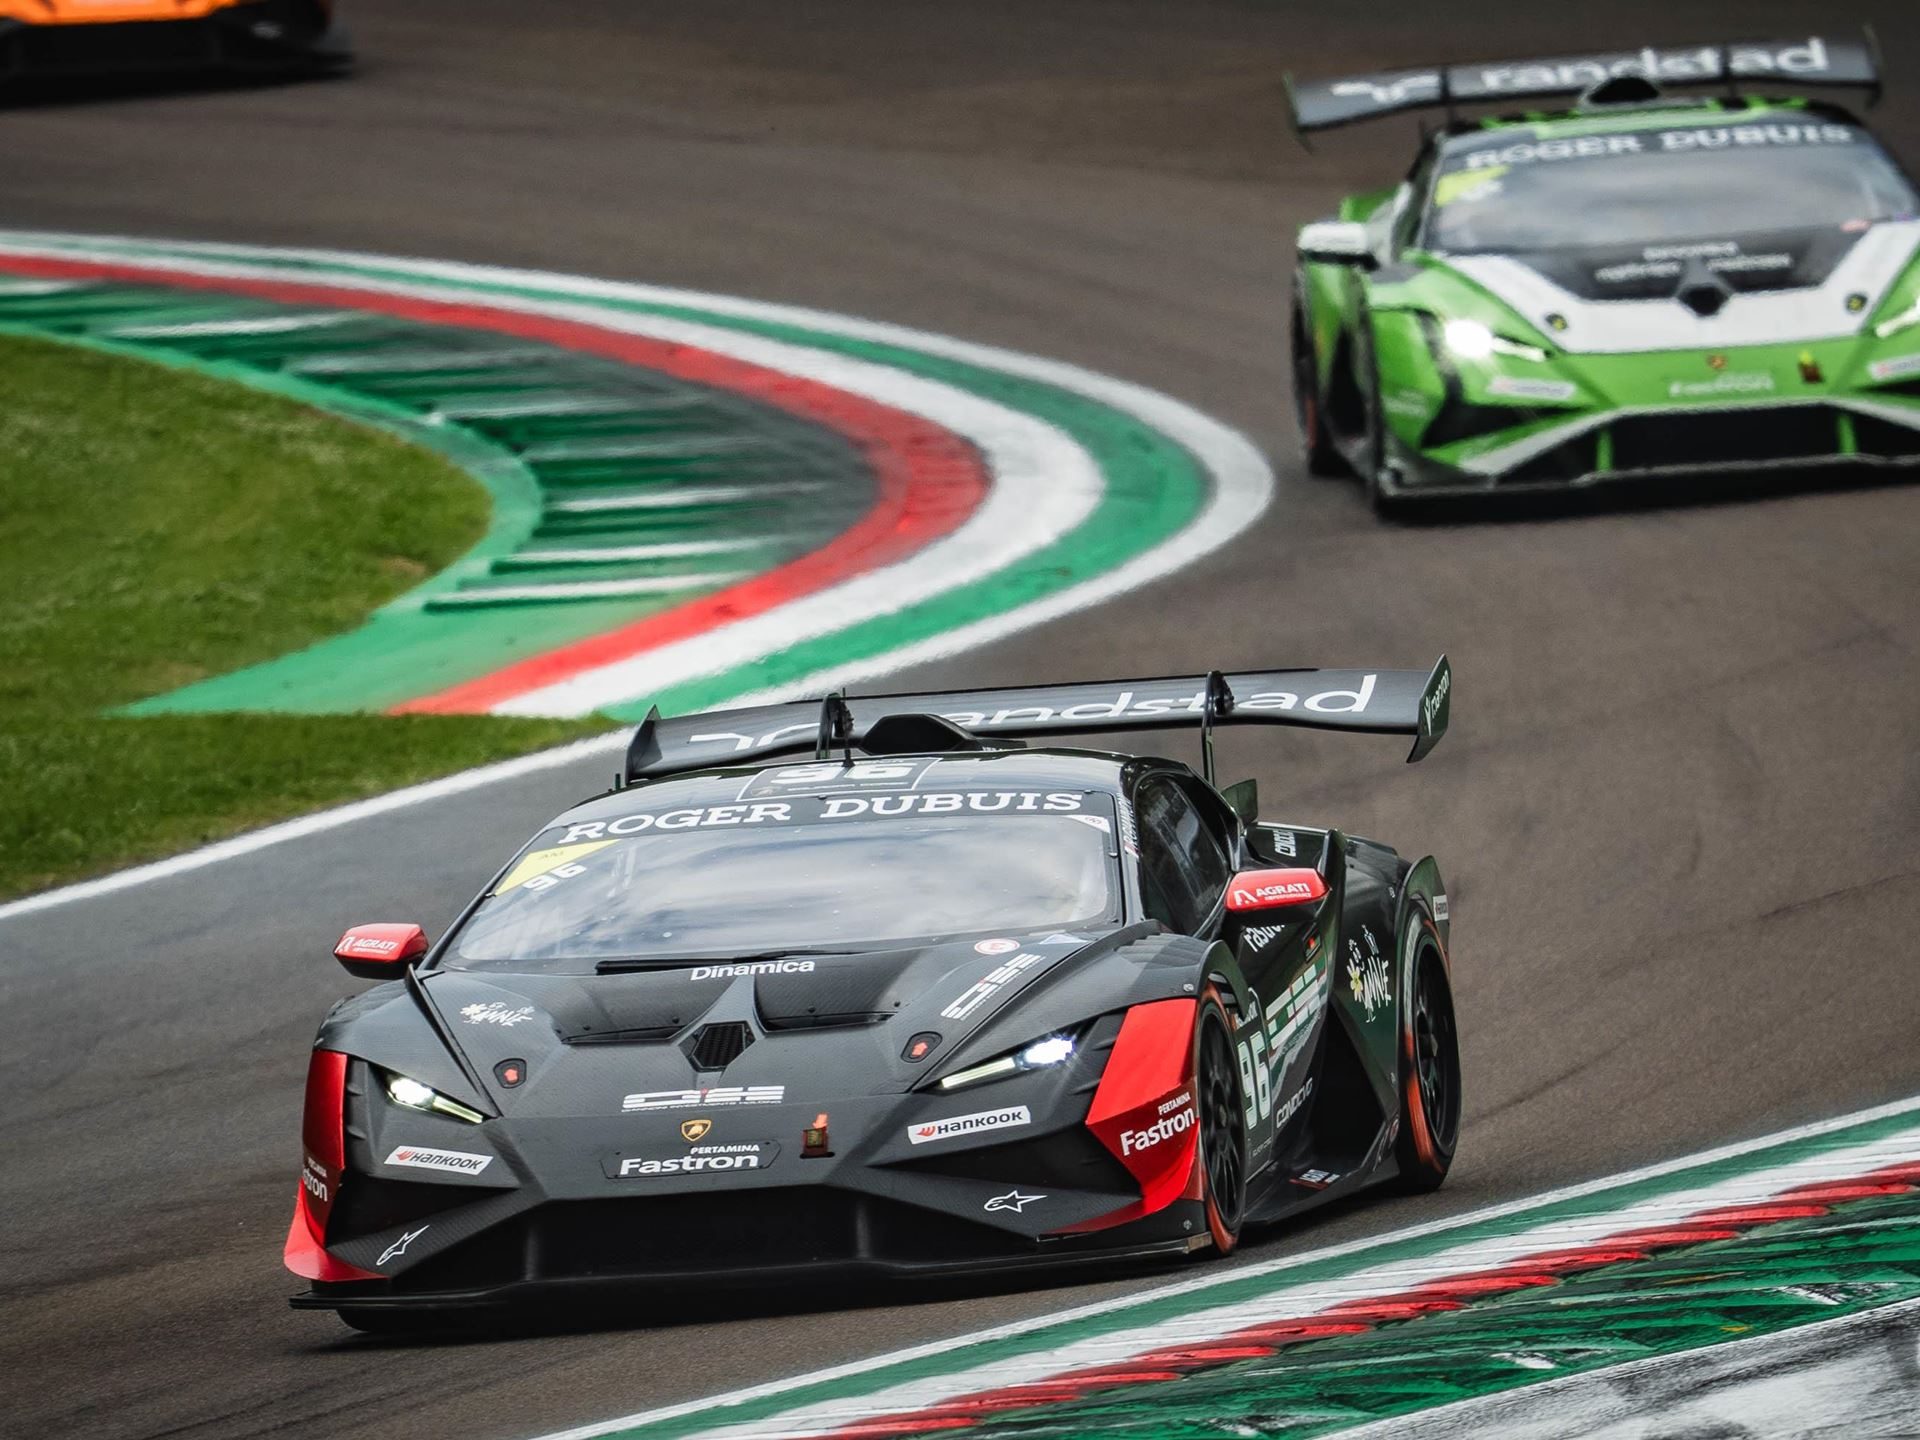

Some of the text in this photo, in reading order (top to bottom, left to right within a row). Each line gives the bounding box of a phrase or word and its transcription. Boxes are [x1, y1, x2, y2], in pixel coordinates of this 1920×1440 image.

[1480, 38, 1829, 92] randstad
[1465, 123, 1852, 169] ROGER DUBUIS
[944, 674, 1377, 727] andstad
[558, 791, 1084, 844] ROGER DUBUIS
[522, 862, 587, 892] 96
[1256, 883, 1311, 897] AGRATI
[690, 960, 815, 980] Dinamica
[1237, 1030, 1271, 1130] 96
[1158, 1092, 1191, 1115] PERTAMINA
[690, 1144, 760, 1155] PERTAMINA
[1119, 1107, 1196, 1156] Fastron
[619, 1154, 759, 1176] Fastron
